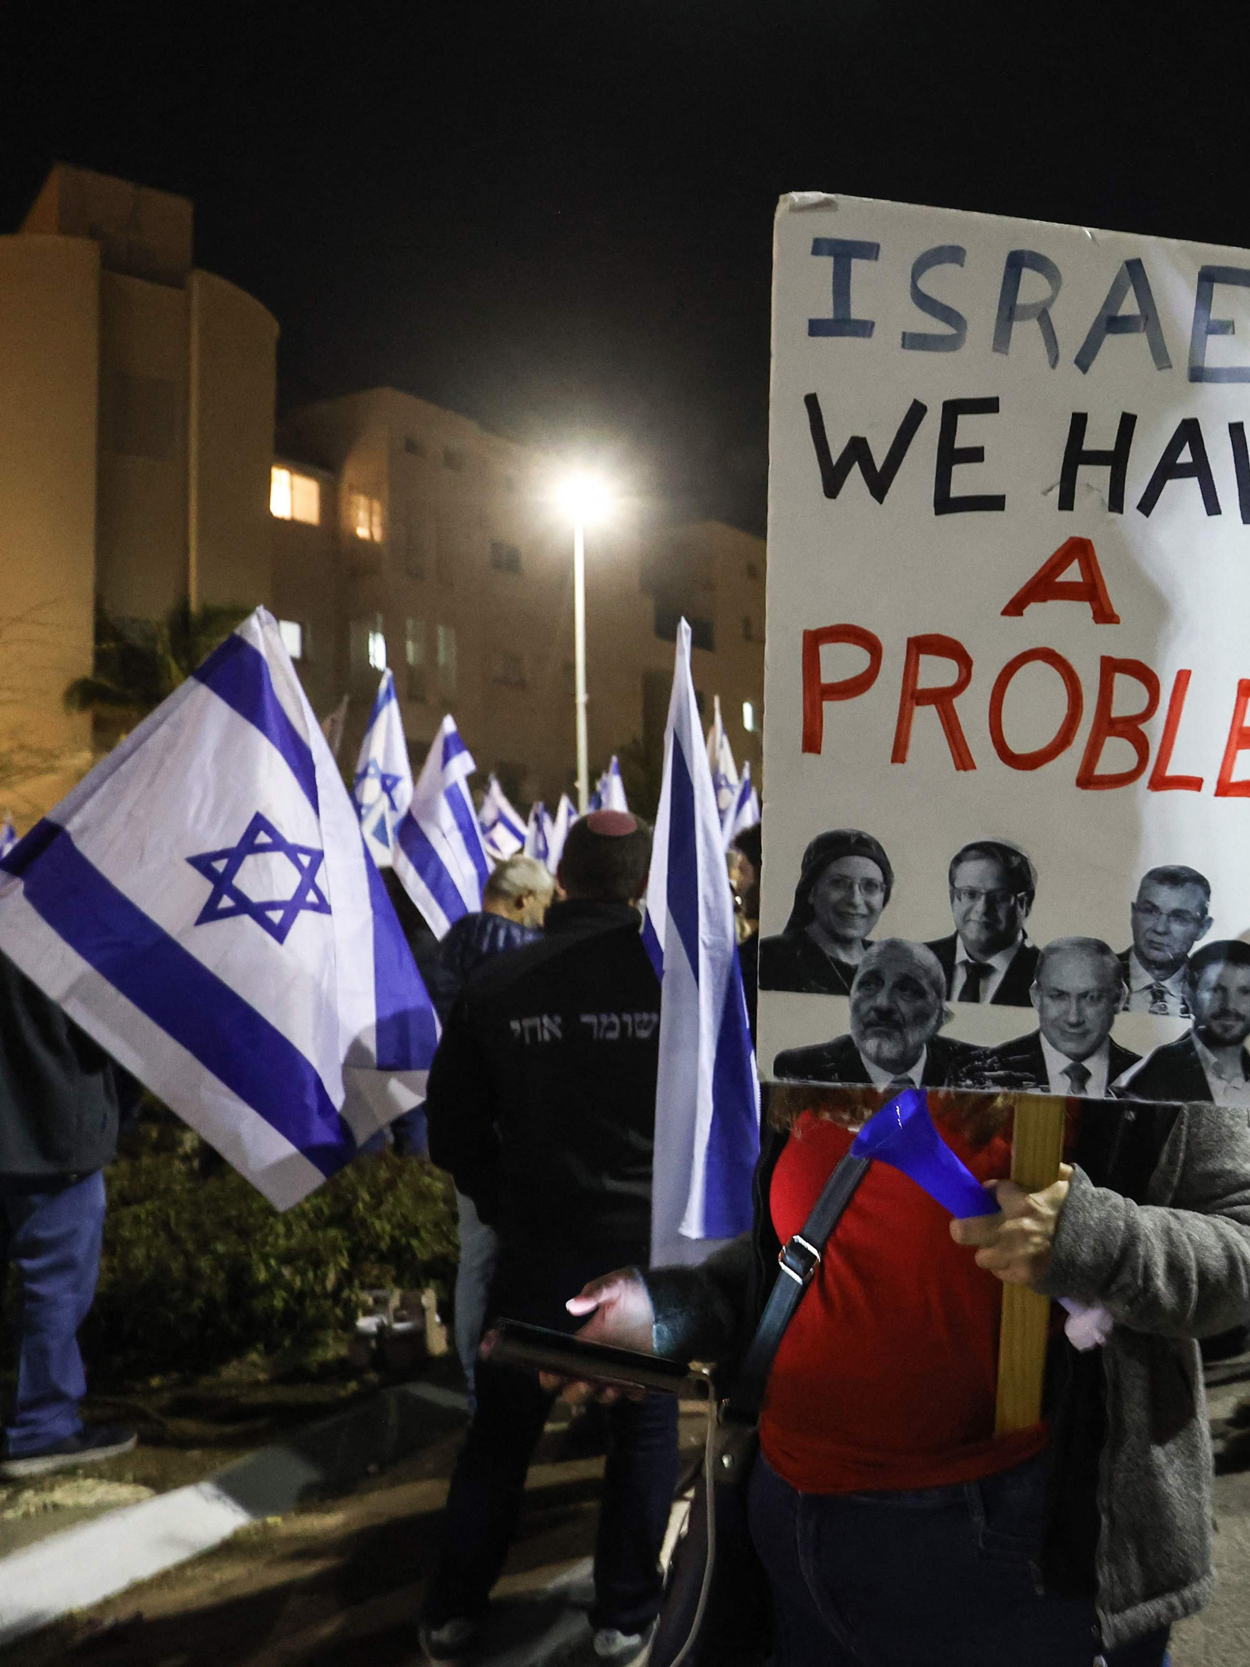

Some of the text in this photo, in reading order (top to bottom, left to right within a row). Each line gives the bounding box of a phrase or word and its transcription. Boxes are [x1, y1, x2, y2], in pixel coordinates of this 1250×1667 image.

[804, 392, 1006, 516] WE
[1000, 536, 1120, 625] A
[509, 1014, 562, 1045] אחי
